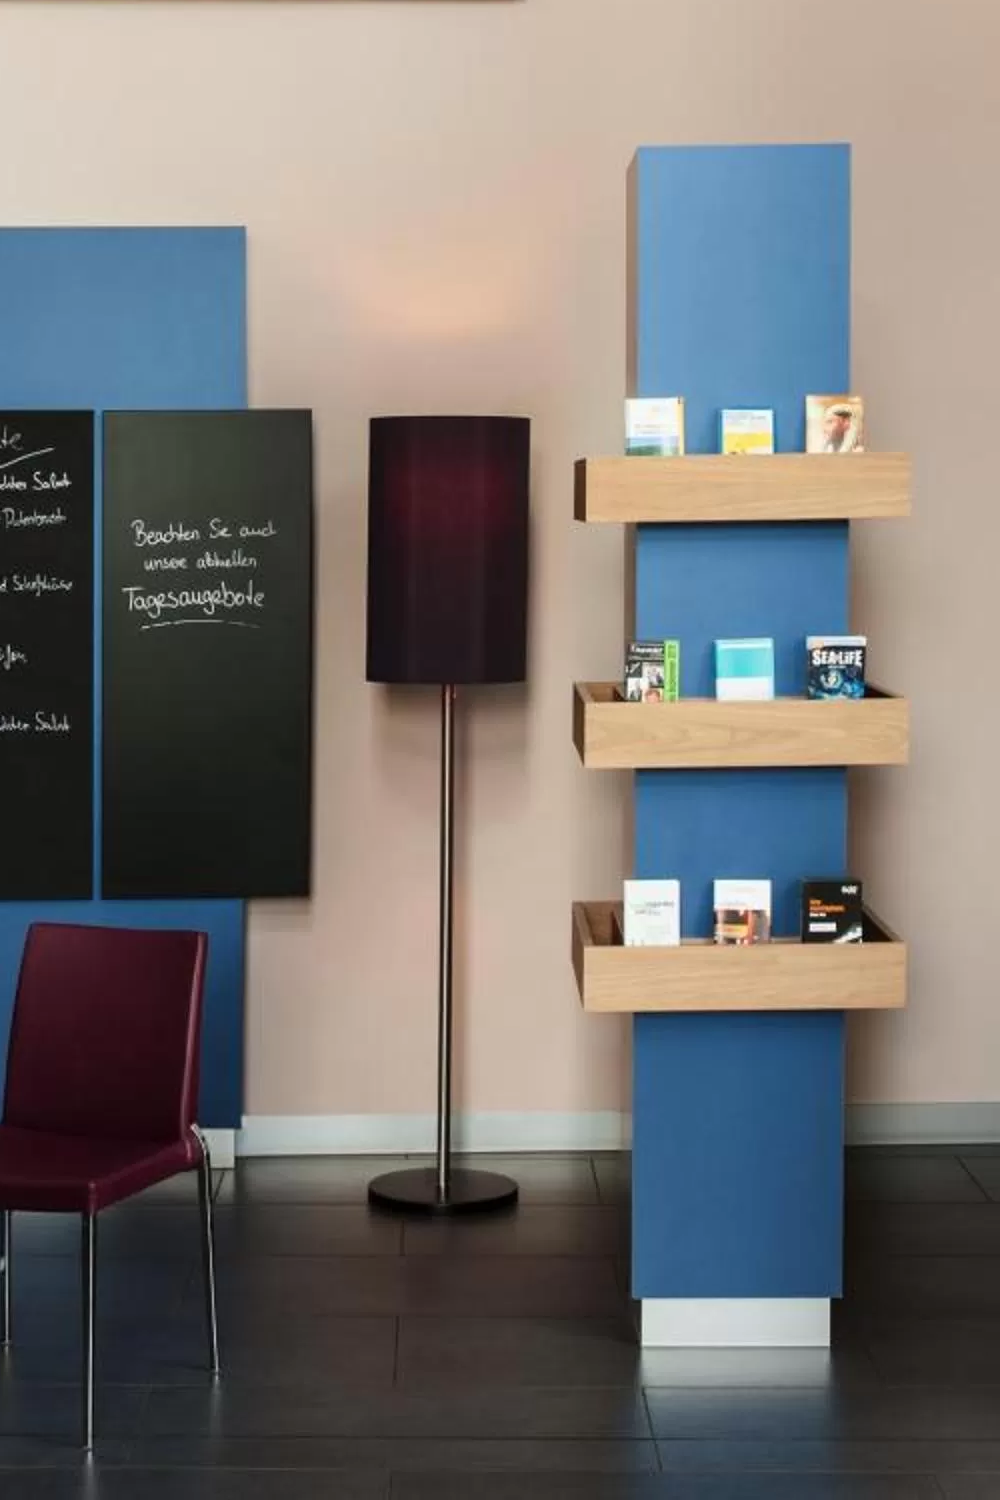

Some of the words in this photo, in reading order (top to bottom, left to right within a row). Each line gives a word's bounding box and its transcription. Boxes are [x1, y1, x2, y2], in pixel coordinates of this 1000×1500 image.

[31, 470, 73, 491] Salat
[130, 518, 201, 548] Beachten
[195, 546, 258, 570] aktuellen
[121, 578, 266, 619] Tagesangebote
[34, 711, 72, 734] Salat
